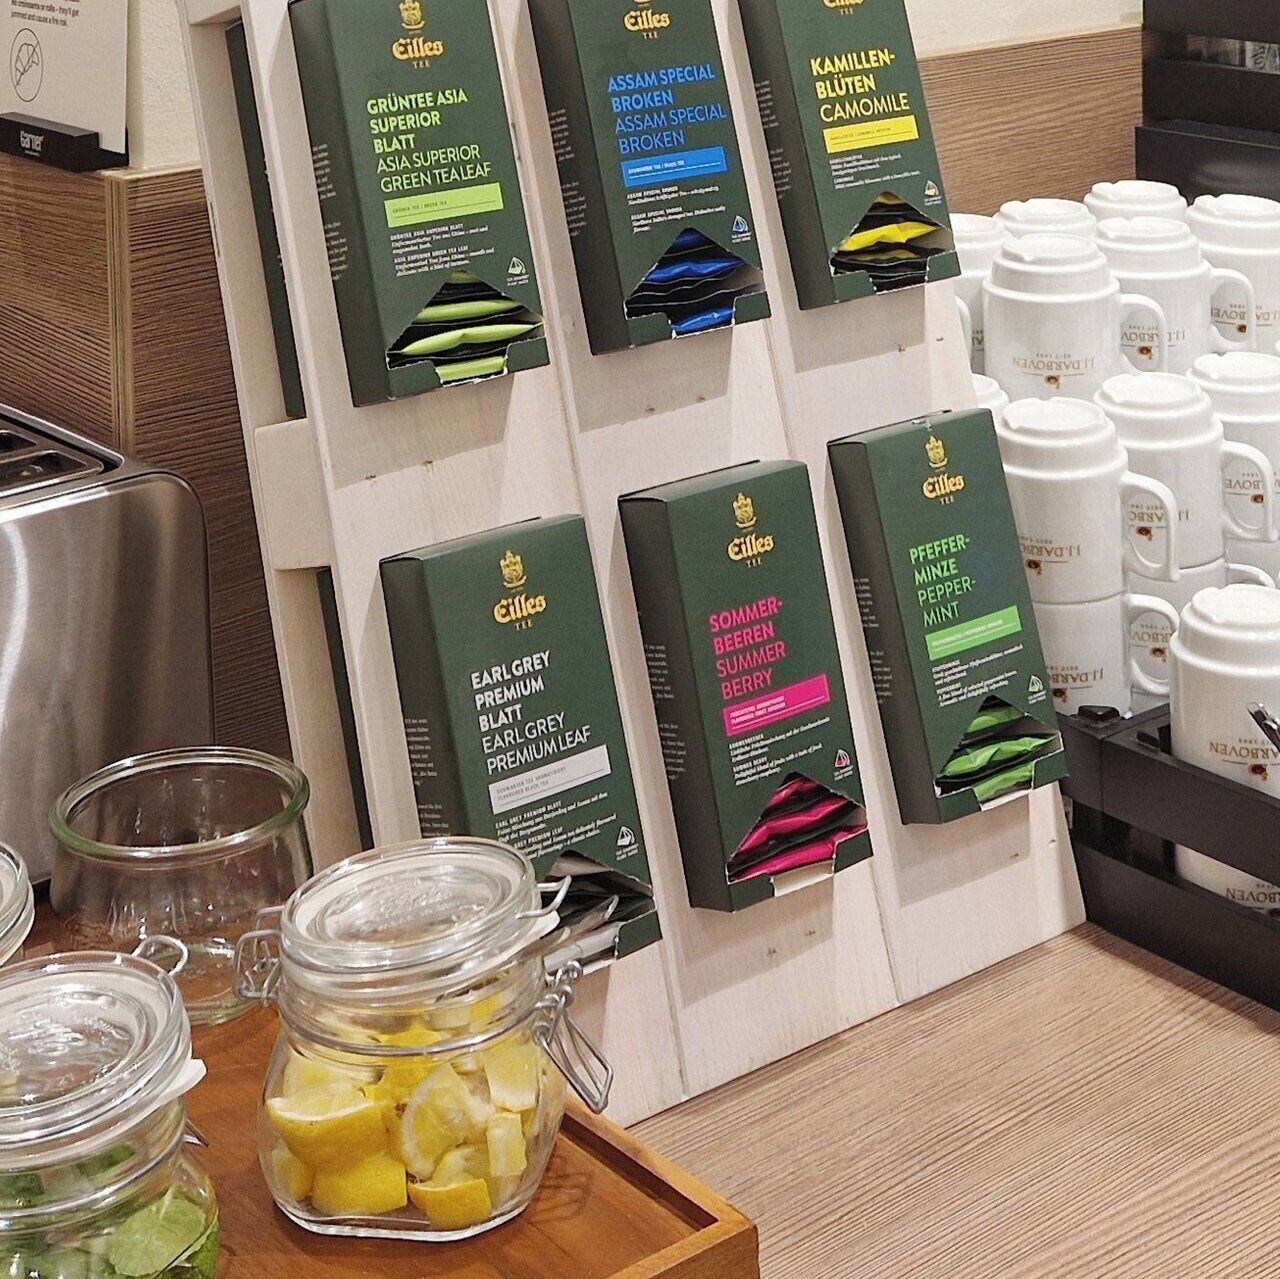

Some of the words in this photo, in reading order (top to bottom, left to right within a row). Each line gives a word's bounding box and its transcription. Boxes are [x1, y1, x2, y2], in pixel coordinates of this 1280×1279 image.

[810, 48, 896, 77] KAMILLEN-
[608, 71, 658, 93] ASSAM
[660, 64, 716, 85] SPECIAL
[815, 73, 877, 100] BLÜTEN
[366, 91, 435, 114] GRÜNTEE
[436, 87, 468, 105] ASIA
[611, 90, 674, 113] BROKEN
[820, 92, 911, 123] CAMOMILE
[369, 110, 441, 135] SUPERIOR
[615, 112, 668, 134] ASSAM
[669, 103, 727, 126] SPECIAL
[373, 133, 416, 155] BLATT
[618, 130, 685, 155] BROKEN
[376, 155, 411, 174] ASIA
[412, 144, 481, 167] SUPERIOR
[380, 171, 433, 193] GREEN
[909, 533, 970, 565] PFEFFER-
[913, 557, 959, 586] MINZE
[918, 577, 976, 607] PEPPER-
[709, 595, 783, 633] SOMMER-
[923, 601, 960, 627] MINT
[713, 621, 775, 656] BEEREN
[470, 665, 512, 690] EARL
[511, 650, 551, 678] GREY
[716, 641, 786, 678] SUMMER
[474, 675, 545, 711] PREMIUM
[720, 668, 773, 700] BERRY
[478, 704, 523, 732] BLATT
[481, 727, 524, 754] EARL
[524, 711, 567, 742] GREY
[486, 741, 559, 776] PREMIUM
[558, 725, 592, 751] LEAF
